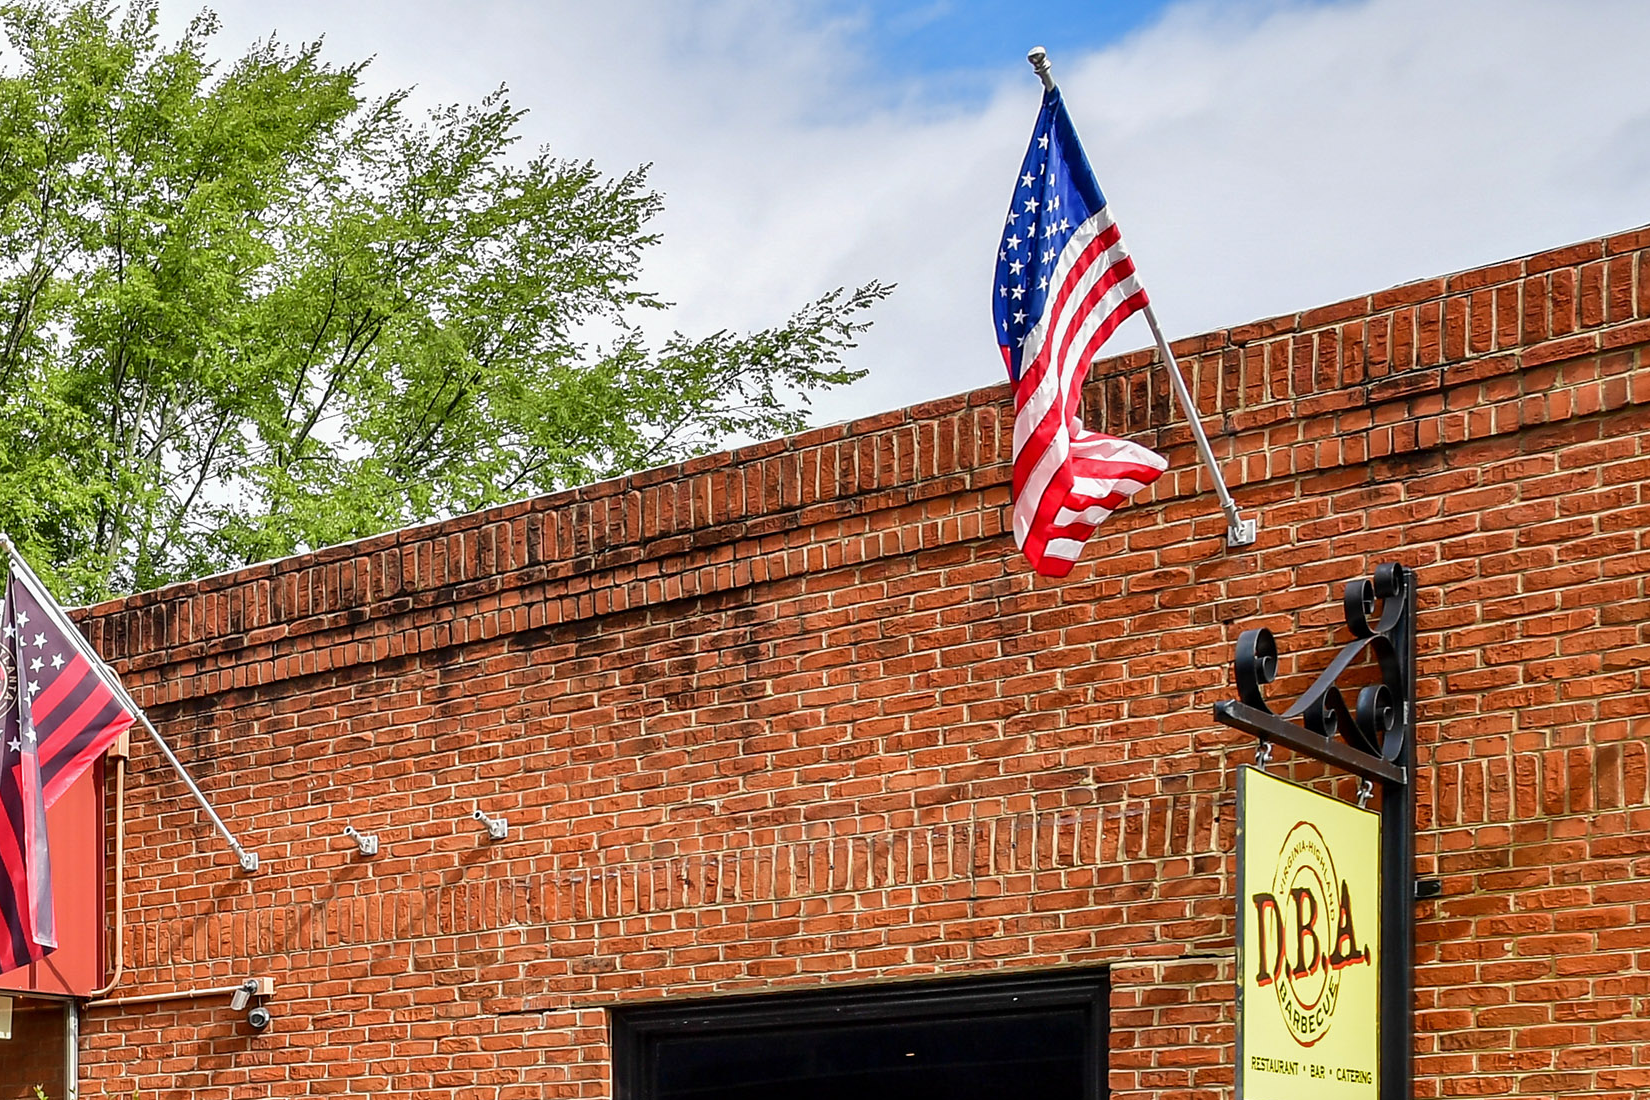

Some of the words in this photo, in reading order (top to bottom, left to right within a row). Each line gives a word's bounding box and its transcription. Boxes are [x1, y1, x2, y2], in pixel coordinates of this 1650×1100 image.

[1279, 840, 1337, 922] VIRGINIA-HIGHLAND
[1252, 879, 1371, 987] D.B.A.
[1279, 975, 1339, 1034] BARBECUE
[1251, 1056, 1299, 1076] RESTAURANT
[1310, 1064, 1326, 1079] BAR
[1336, 1068, 1373, 1085] CATERING
